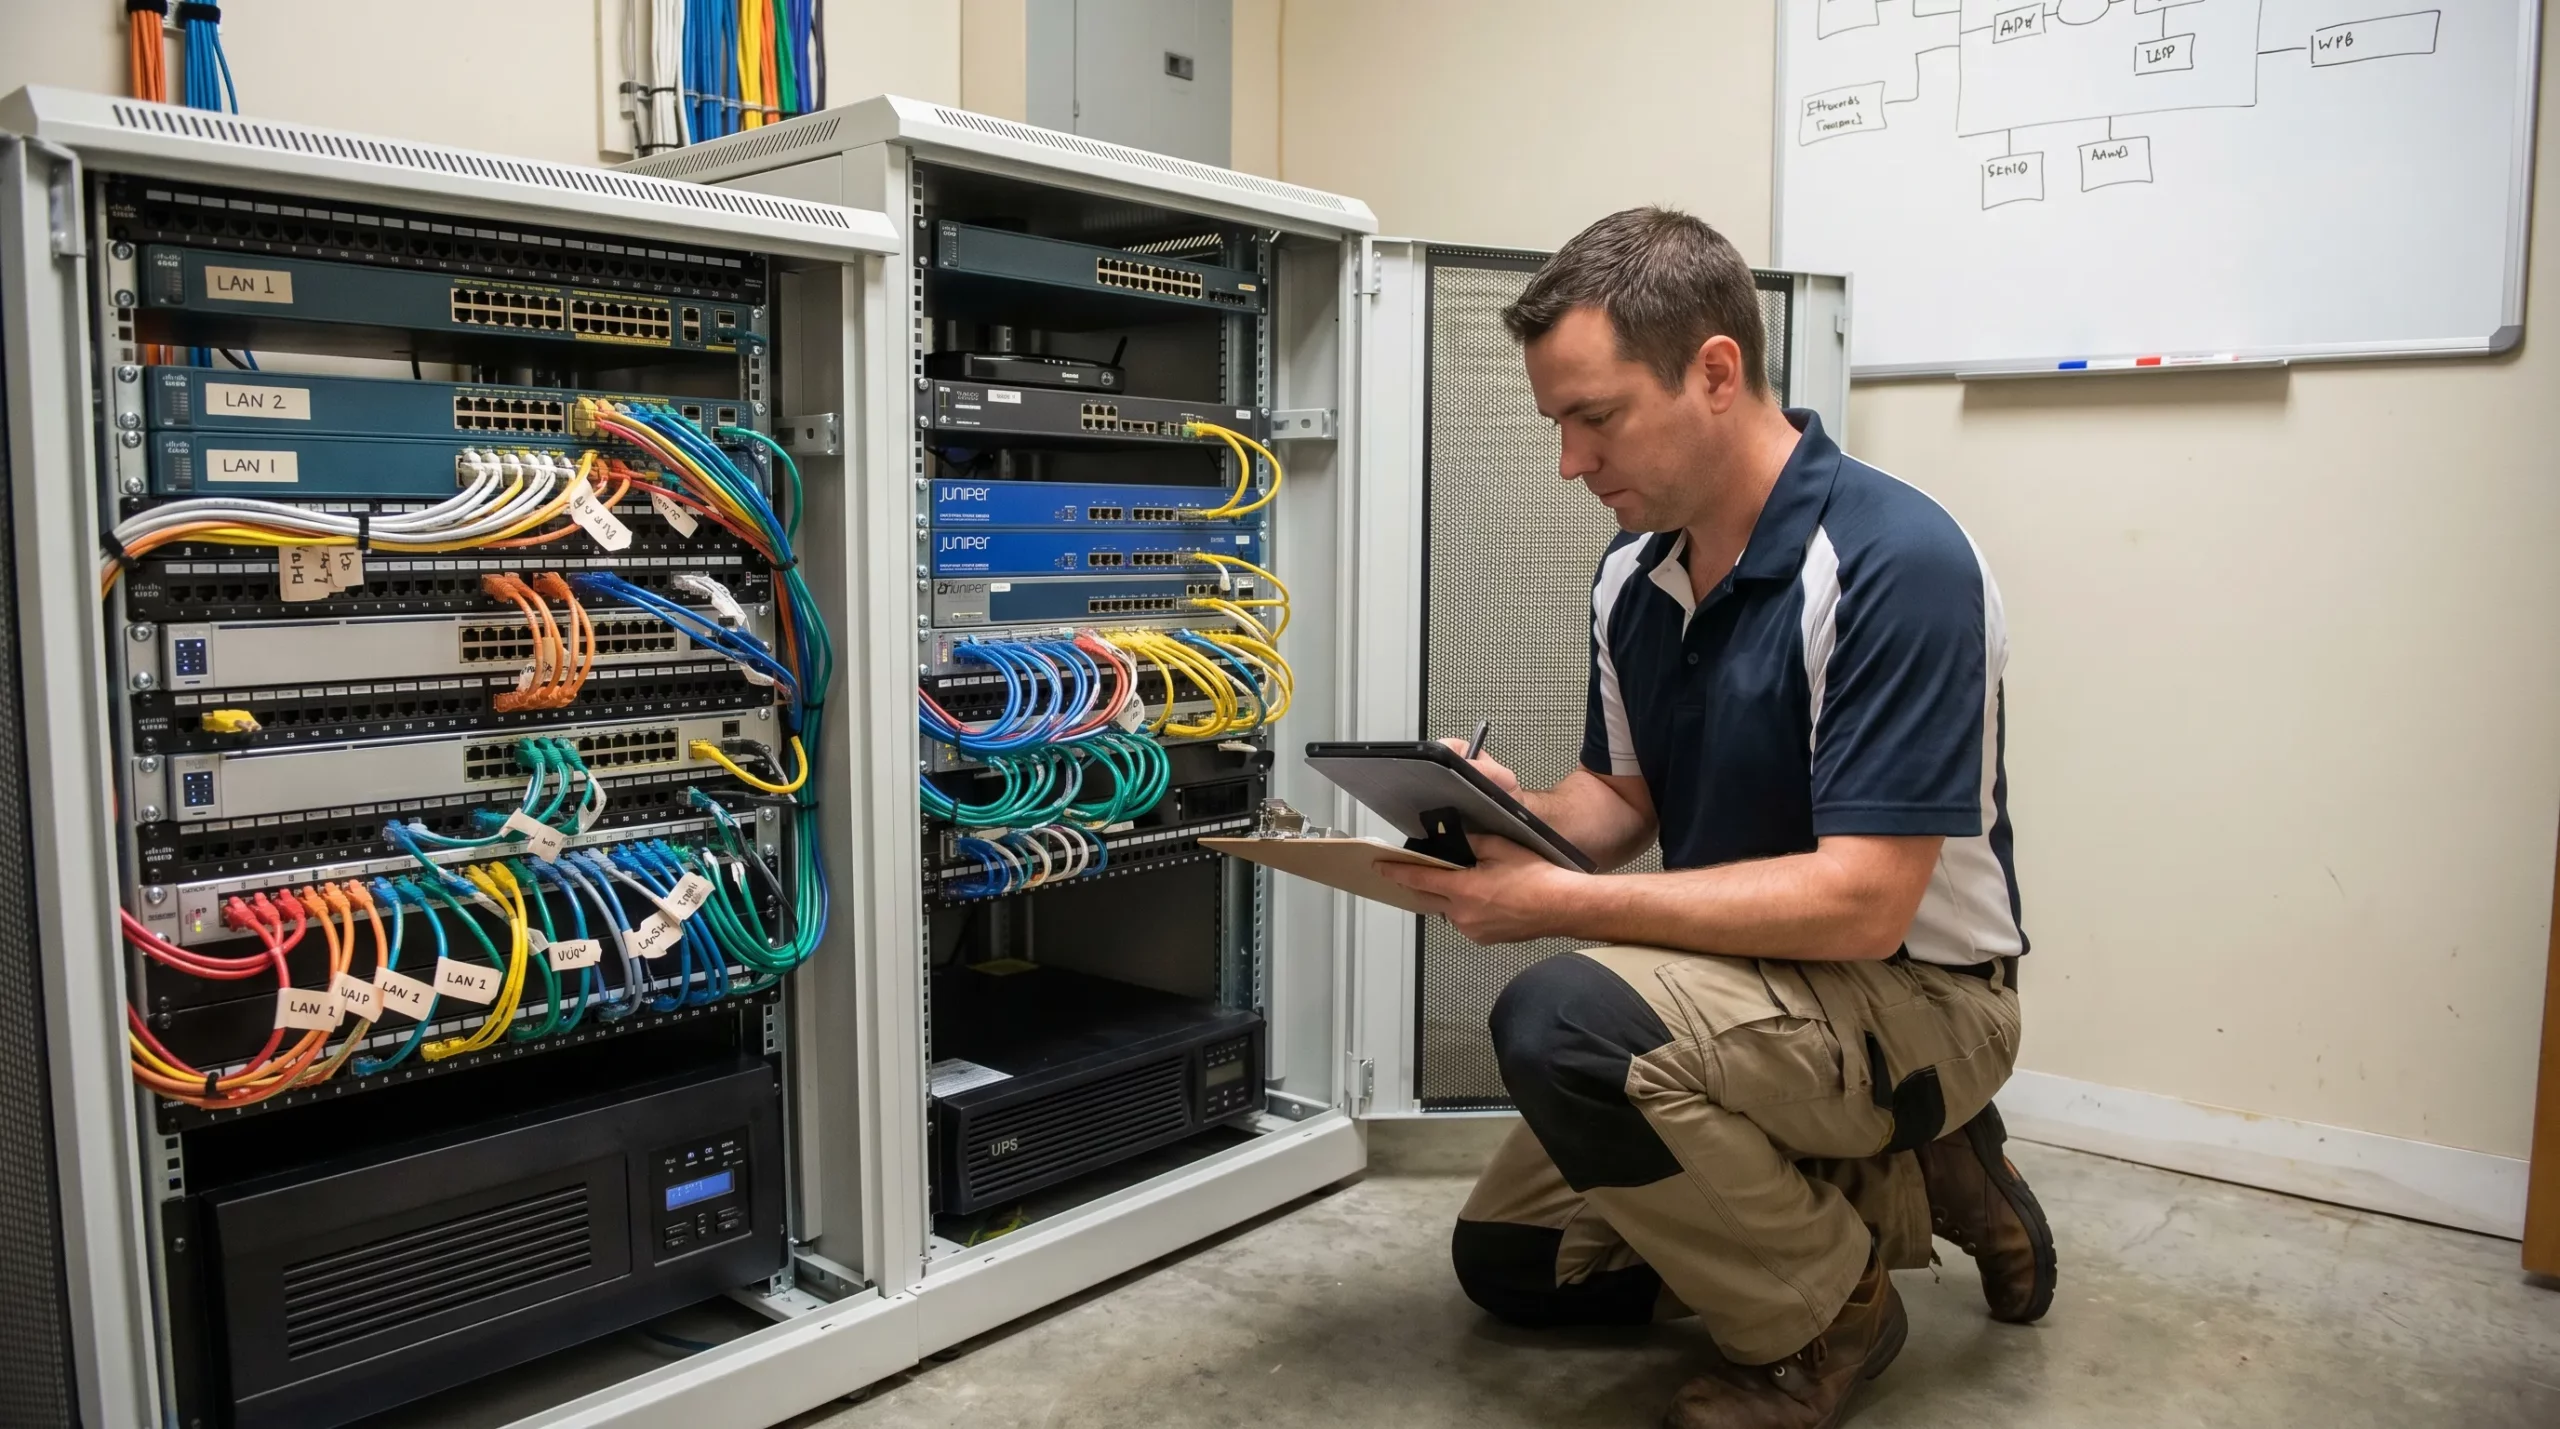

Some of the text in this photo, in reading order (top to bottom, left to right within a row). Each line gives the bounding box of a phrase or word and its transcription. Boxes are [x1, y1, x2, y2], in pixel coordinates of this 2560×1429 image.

[217, 275, 274, 294] LAN 1
[226, 391, 286, 409] LAN 2
[223, 458, 260, 474] LAN
[447, 972, 486, 990] LAN 1
[382, 981, 421, 1004] LAN 1
[290, 1000, 336, 1018] LAN 1
[992, 1137, 1018, 1156] UPS
